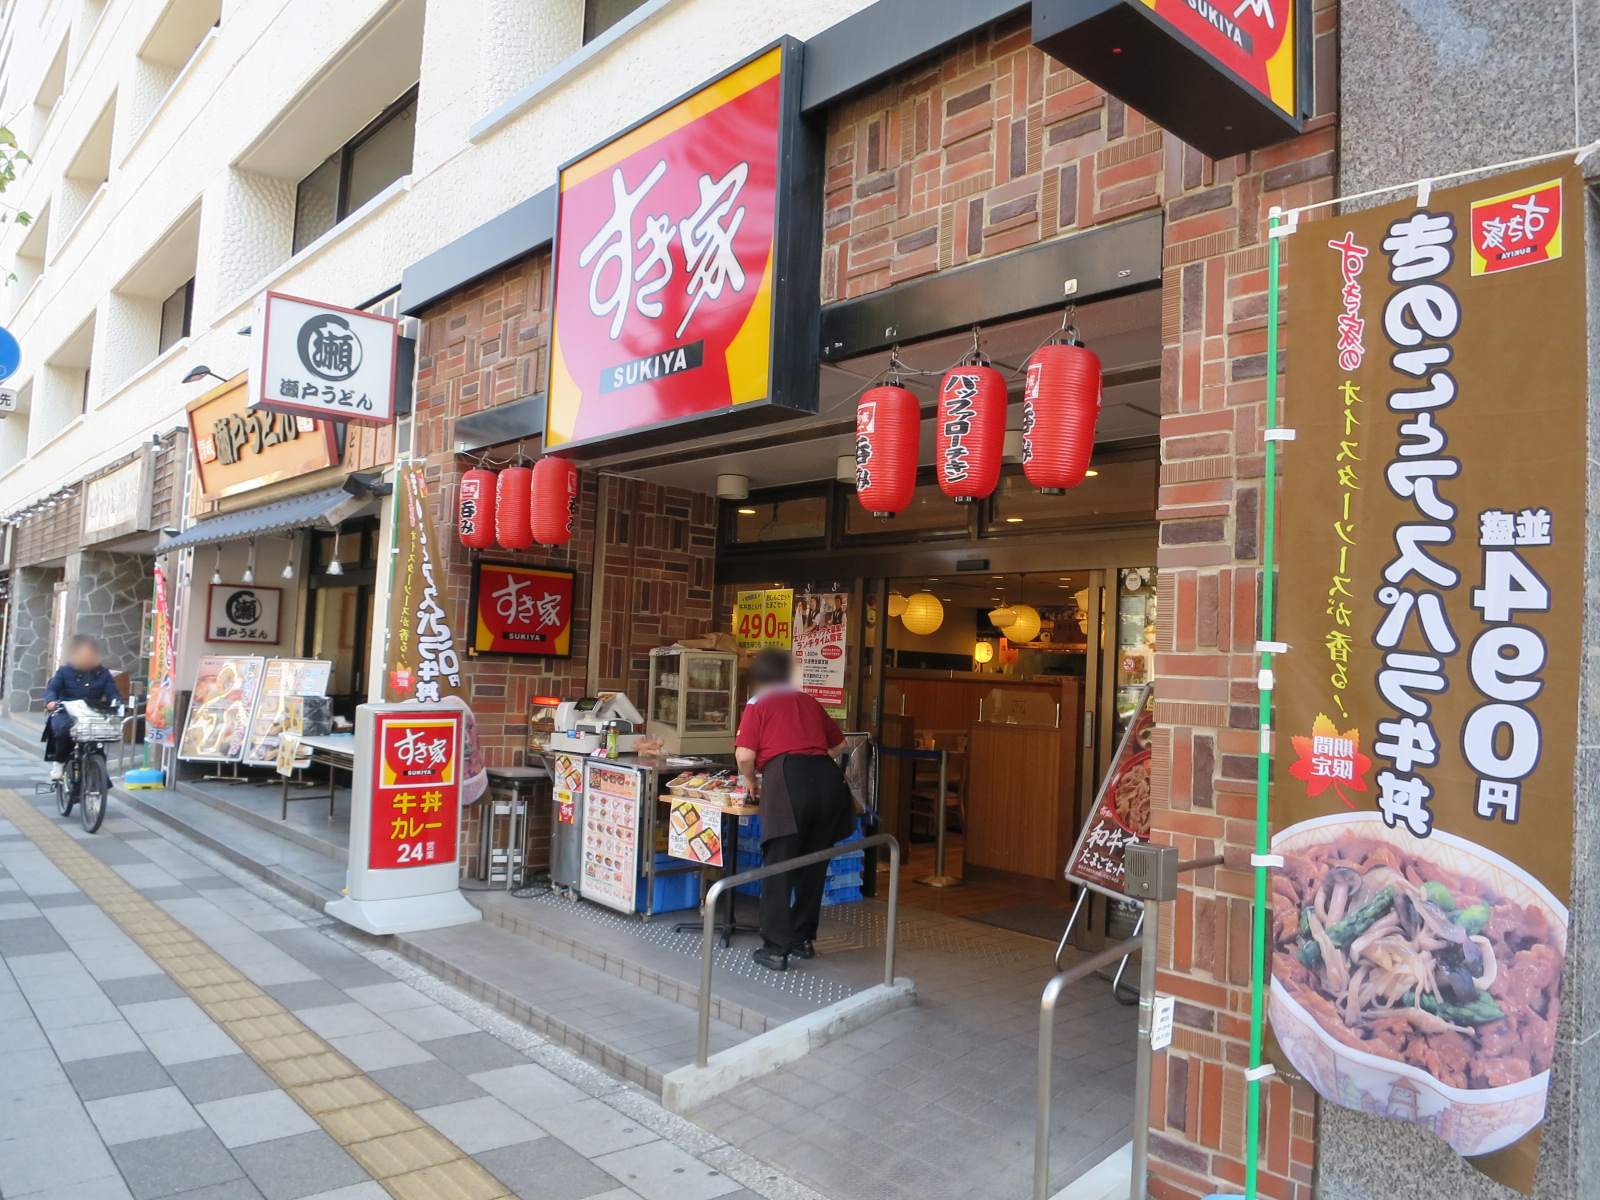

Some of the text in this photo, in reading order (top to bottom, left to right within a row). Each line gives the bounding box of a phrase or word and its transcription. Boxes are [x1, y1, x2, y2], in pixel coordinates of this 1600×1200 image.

[579, 159, 749, 339] すき家
[612, 349, 688, 389] SUKIYA
[279, 378, 374, 412] 瀬戸うどん
[944, 374, 980, 484] バッファローチキン
[492, 574, 562, 632] すき家
[216, 626, 268, 639] 瀬戸うどん
[508, 633, 541, 642] SUKIYA
[739, 613, 789, 639] 490円
[393, 728, 447, 770] すき家
[390, 790, 443, 815] 牛丼
[390, 817, 443, 840] カレー
[396, 842, 423, 863] 24
